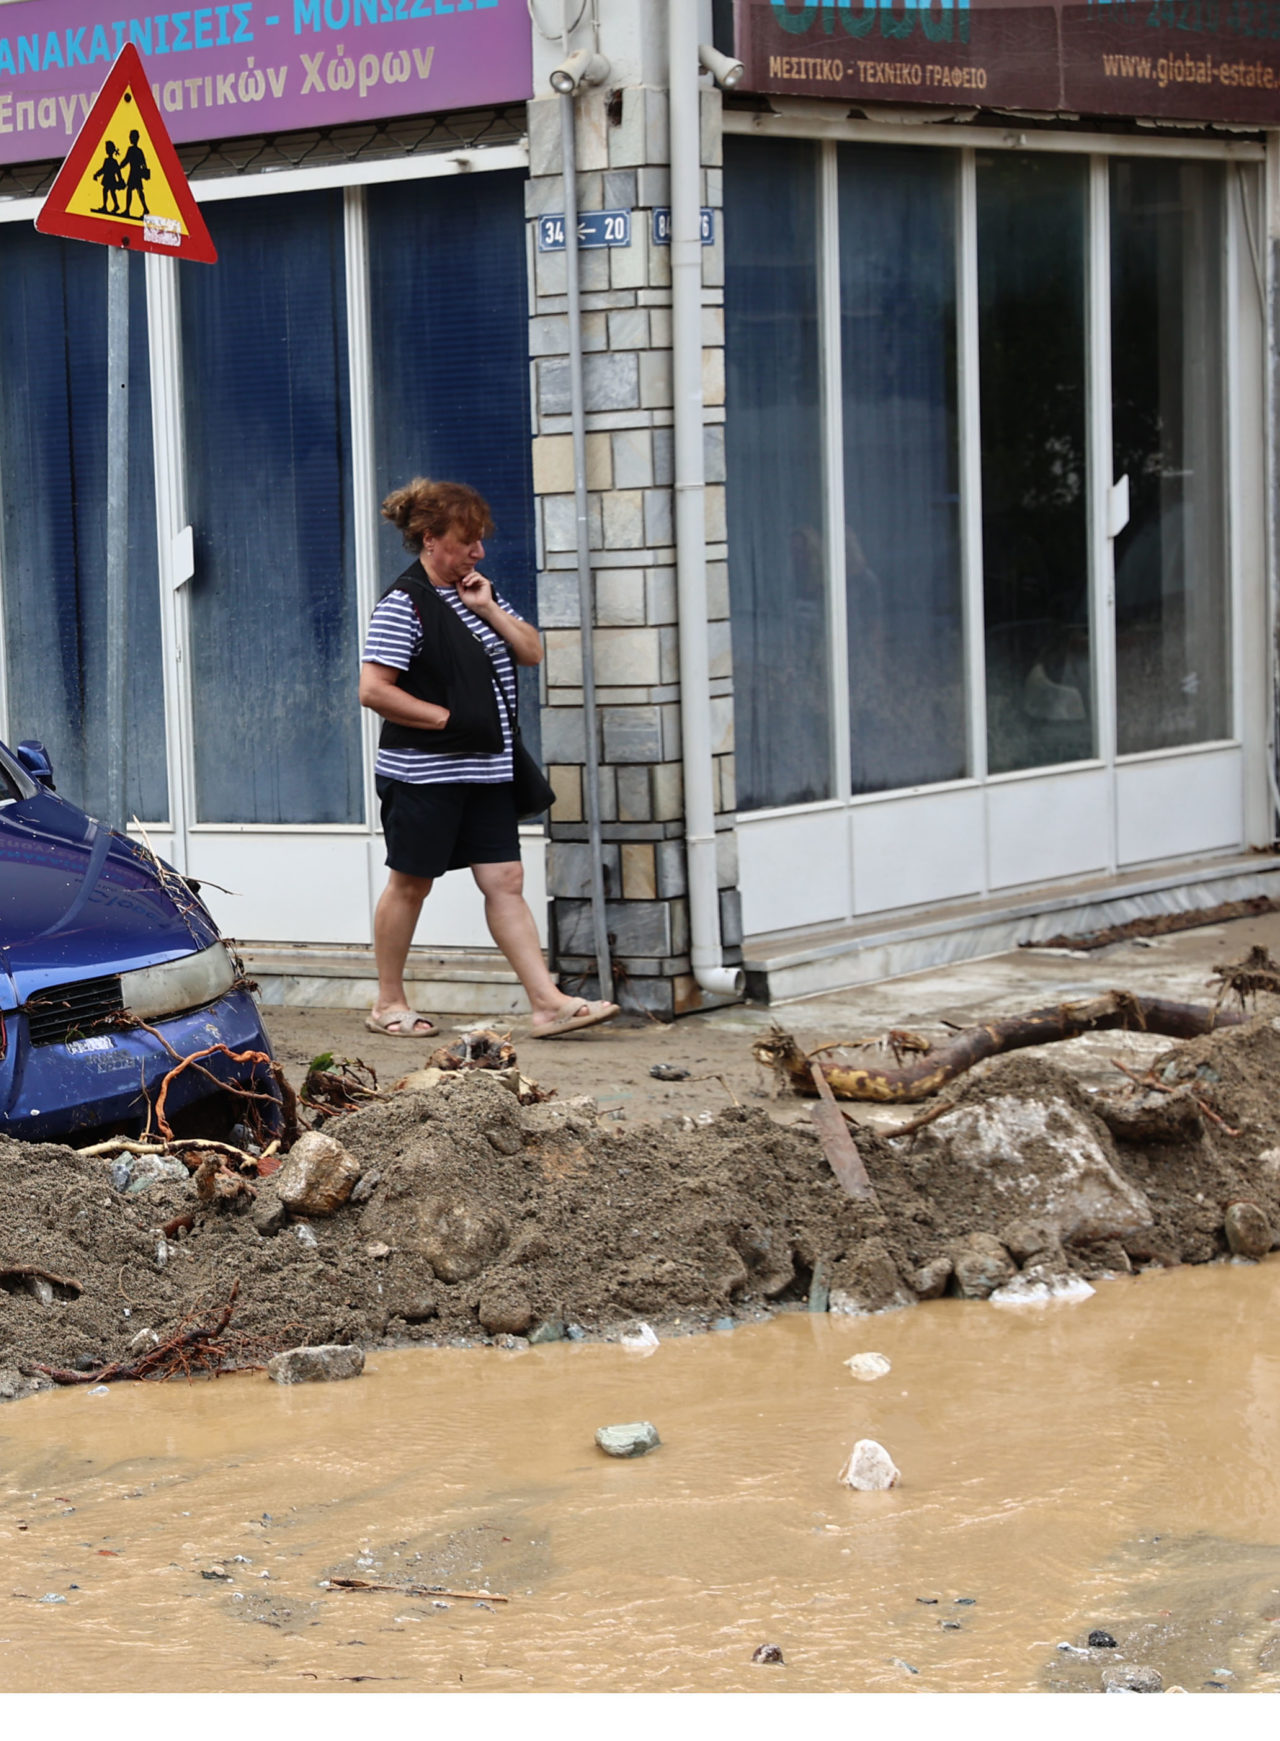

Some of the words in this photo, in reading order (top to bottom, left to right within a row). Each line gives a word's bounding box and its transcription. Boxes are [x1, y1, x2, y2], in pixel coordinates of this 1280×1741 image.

[300, 45, 434, 97] Χώρων
[769, 56, 843, 81] ΜΕΣΙΤΙΚΟ
[857, 60, 921, 85] ΤΕΧΝΙΚΟ
[925, 65, 987, 89] ΓΡΑΦΕΙΟ
[545, 221, 564, 244] 34
[604, 217, 625, 240] 20
